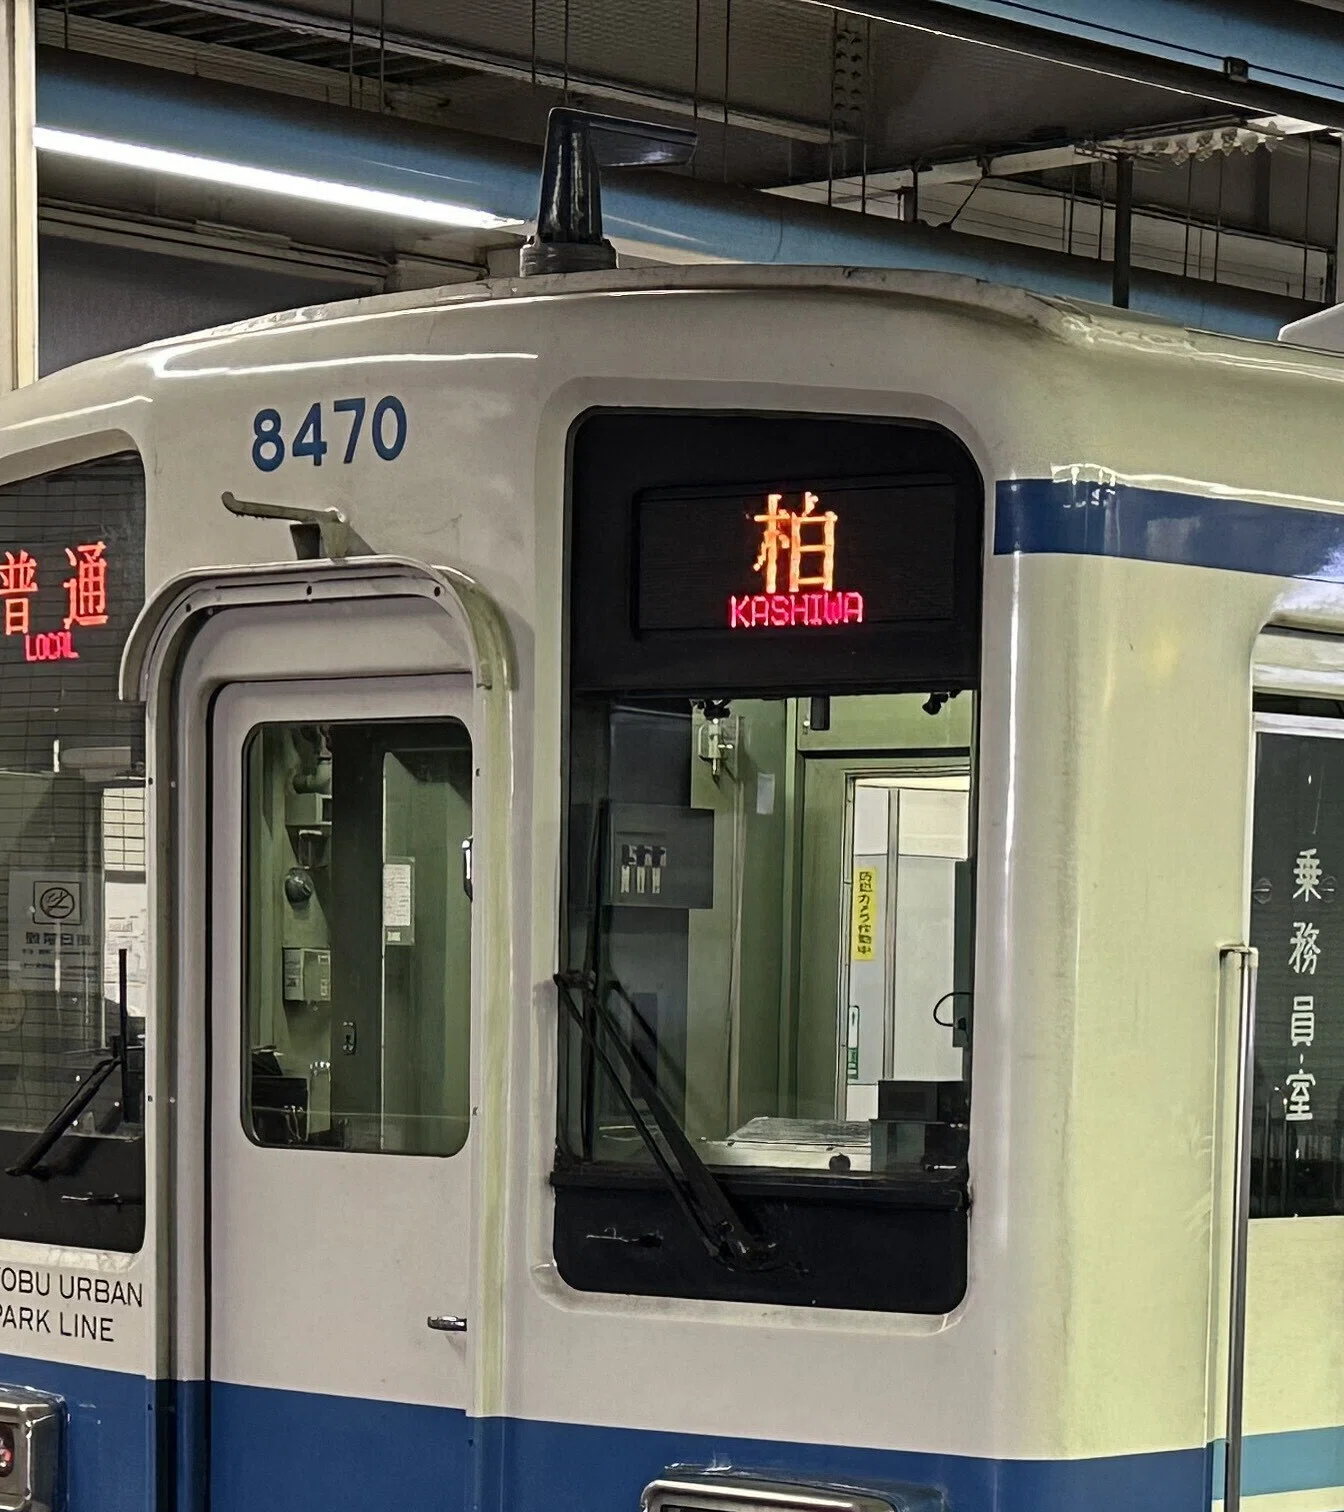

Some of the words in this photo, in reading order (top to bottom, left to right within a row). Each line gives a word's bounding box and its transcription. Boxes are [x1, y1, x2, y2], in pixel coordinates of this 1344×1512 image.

[252, 395, 407, 472] 8470
[753, 491, 838, 594] 柏
[730, 592, 863, 628] KASHIWA
[1287, 848, 1323, 1121] 乗務員室
[59, 1274, 143, 1307] URBAN
[60, 1312, 114, 1342] LINE
